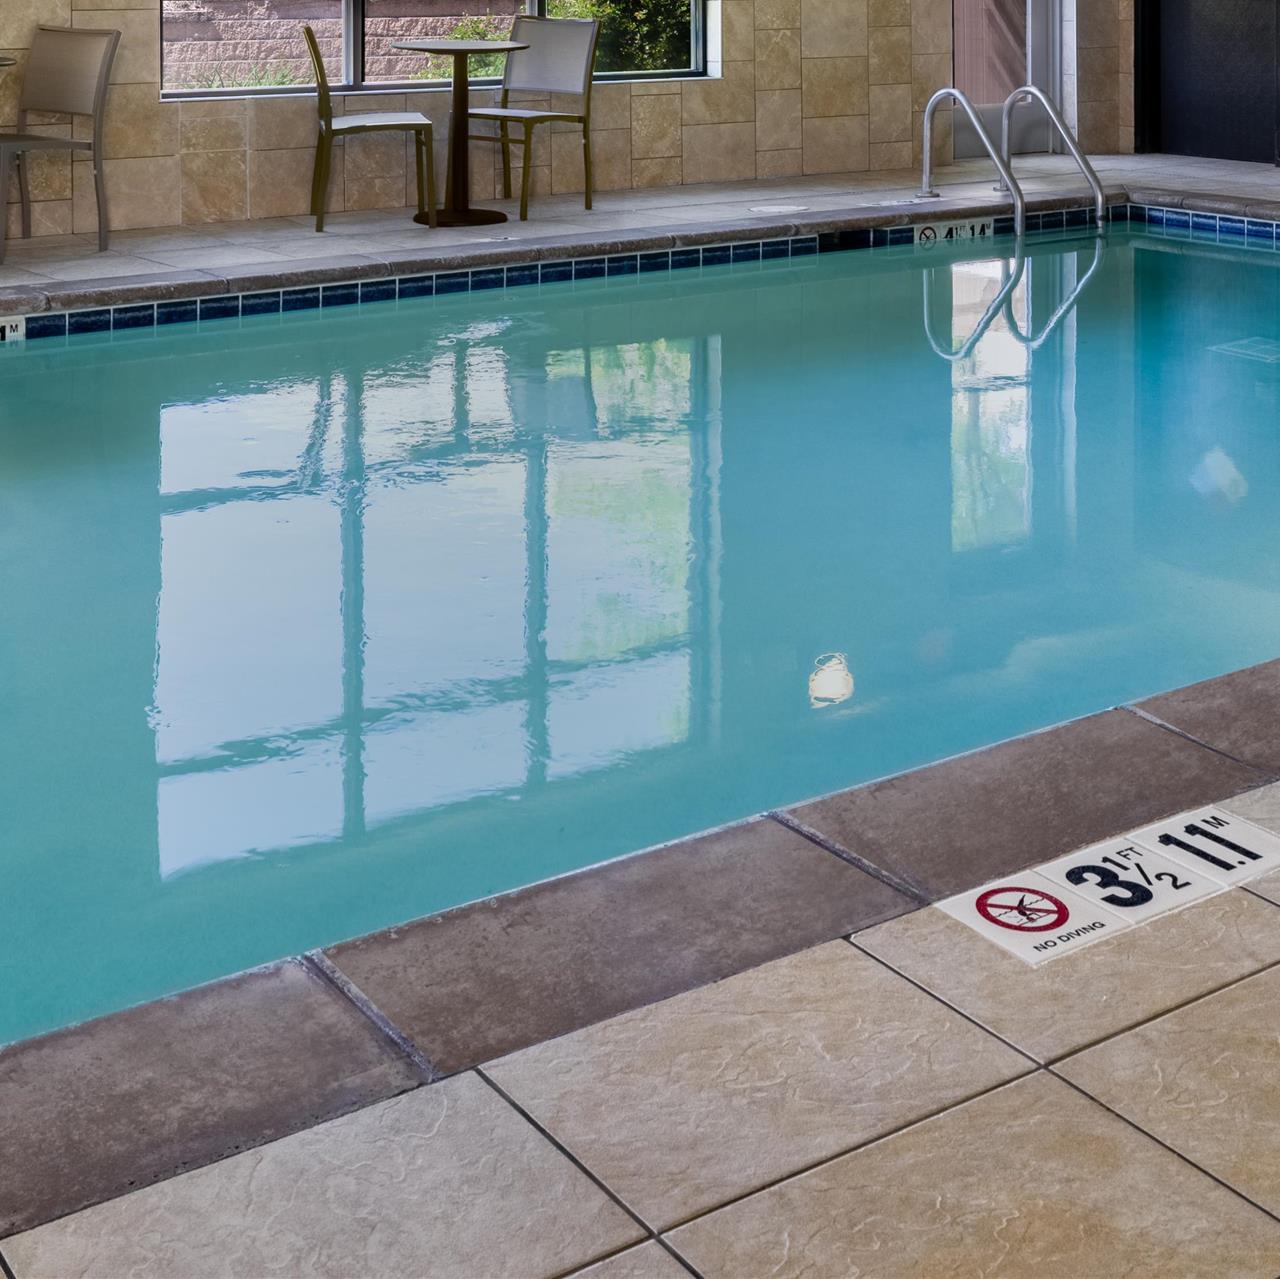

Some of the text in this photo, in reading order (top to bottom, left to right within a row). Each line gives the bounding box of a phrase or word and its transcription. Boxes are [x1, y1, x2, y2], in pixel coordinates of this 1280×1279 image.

[9, 324, 18, 333] M
[1116, 847, 1144, 861] FT
[1158, 815, 1263, 872] 1.1 M
[1033, 920, 1106, 952] NO DIVING
